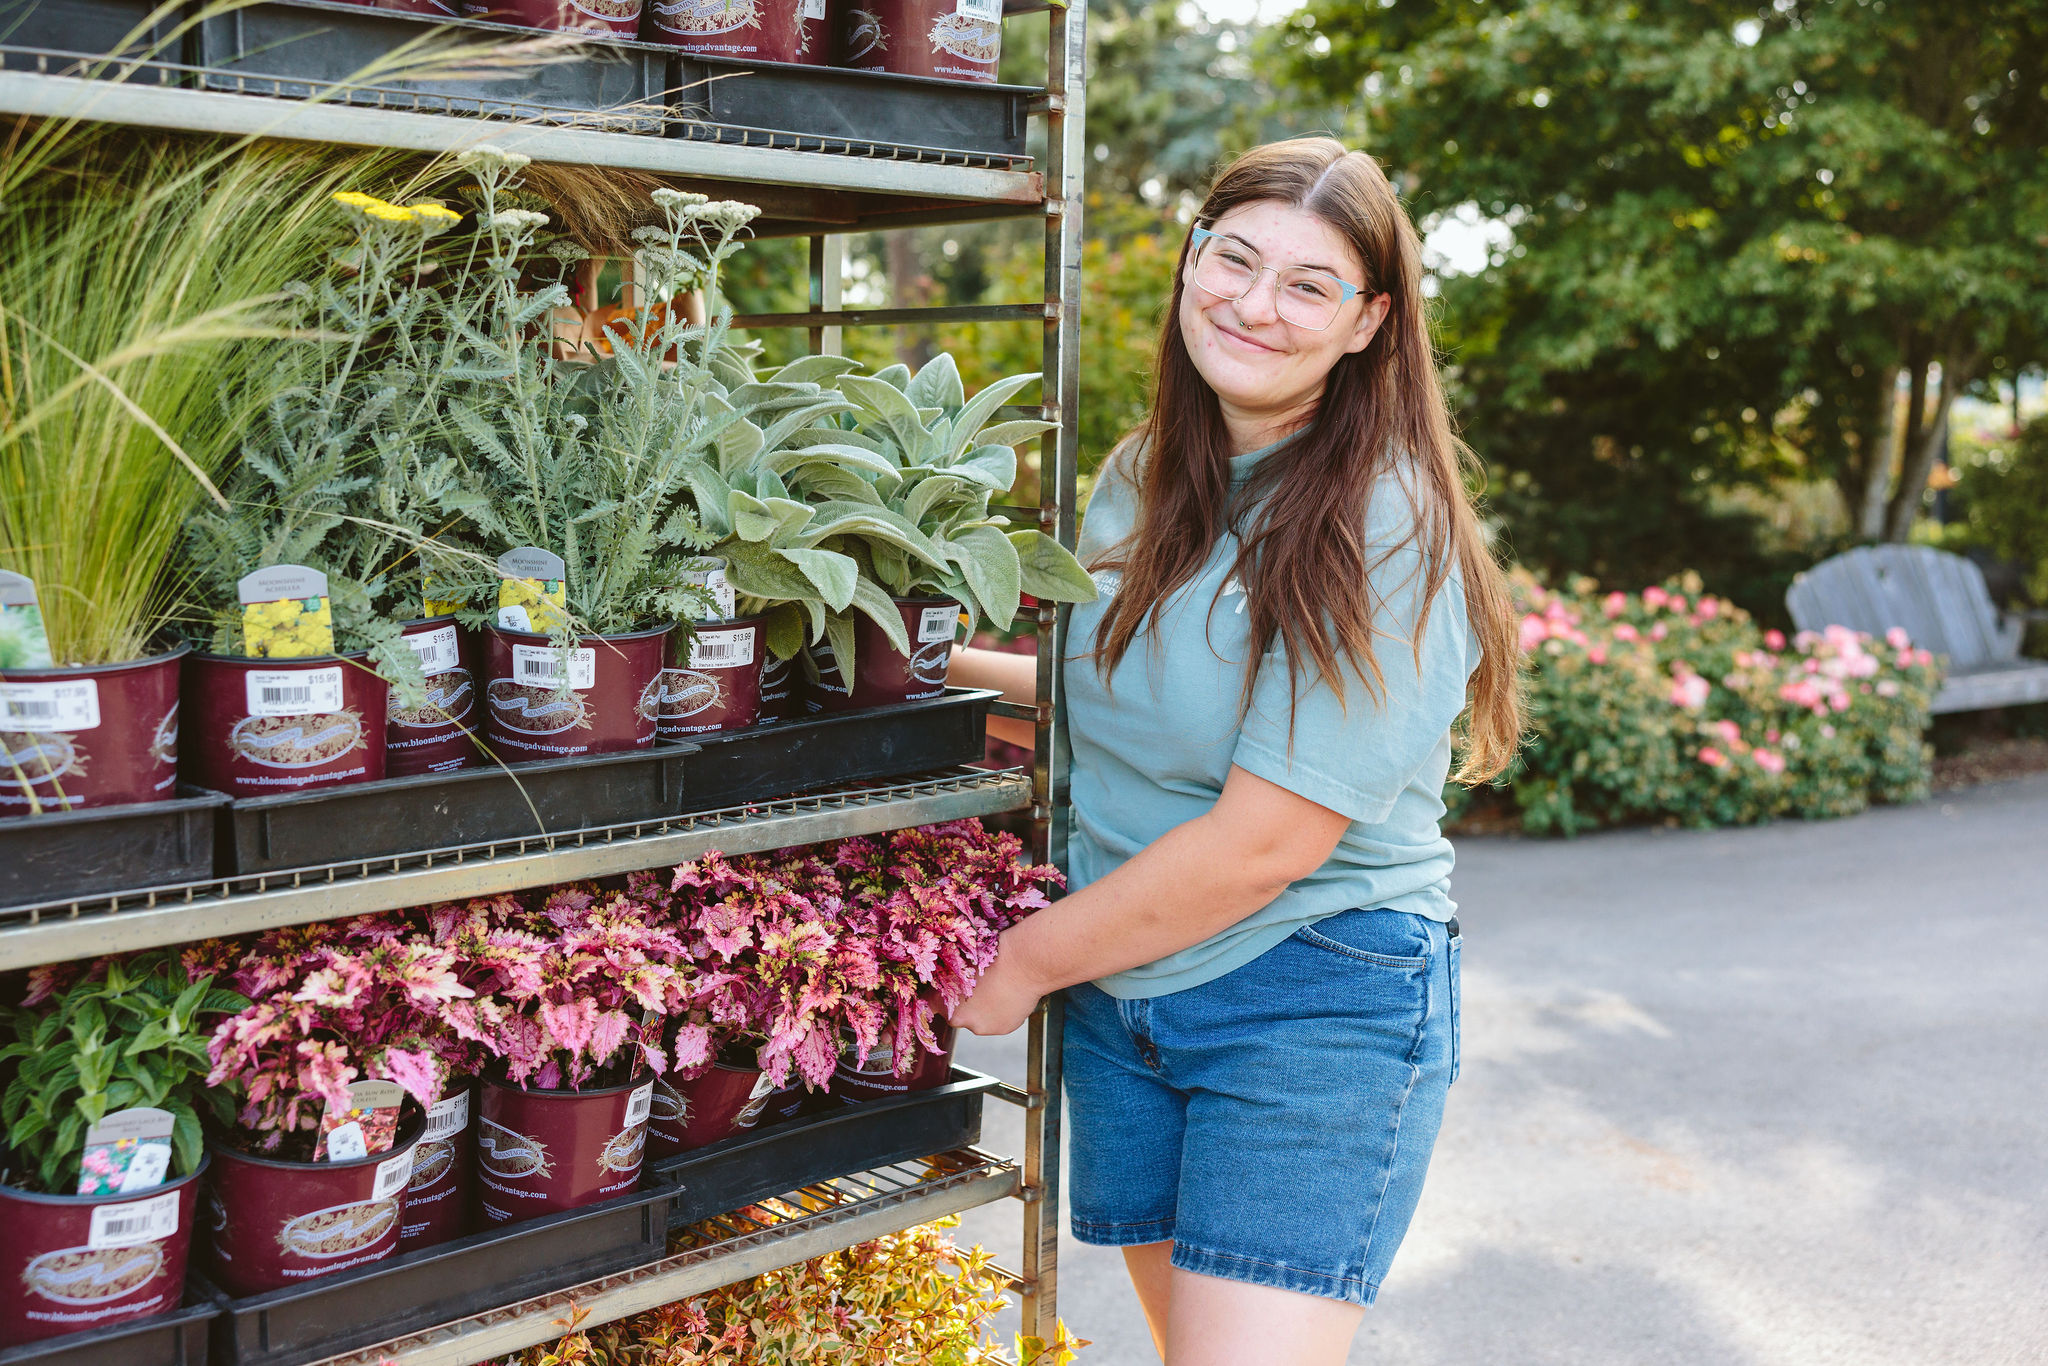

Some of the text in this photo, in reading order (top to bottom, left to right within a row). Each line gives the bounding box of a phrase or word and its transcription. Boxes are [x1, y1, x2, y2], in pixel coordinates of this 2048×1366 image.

[732, 632, 752, 642] $13.99
[566, 653, 591, 662] 15.99
[308, 671, 338, 685] $15.99
[236, 766, 367, 787] www.bloomingadvantage.com
[411, 1153, 441, 1174] DVANTAGE
